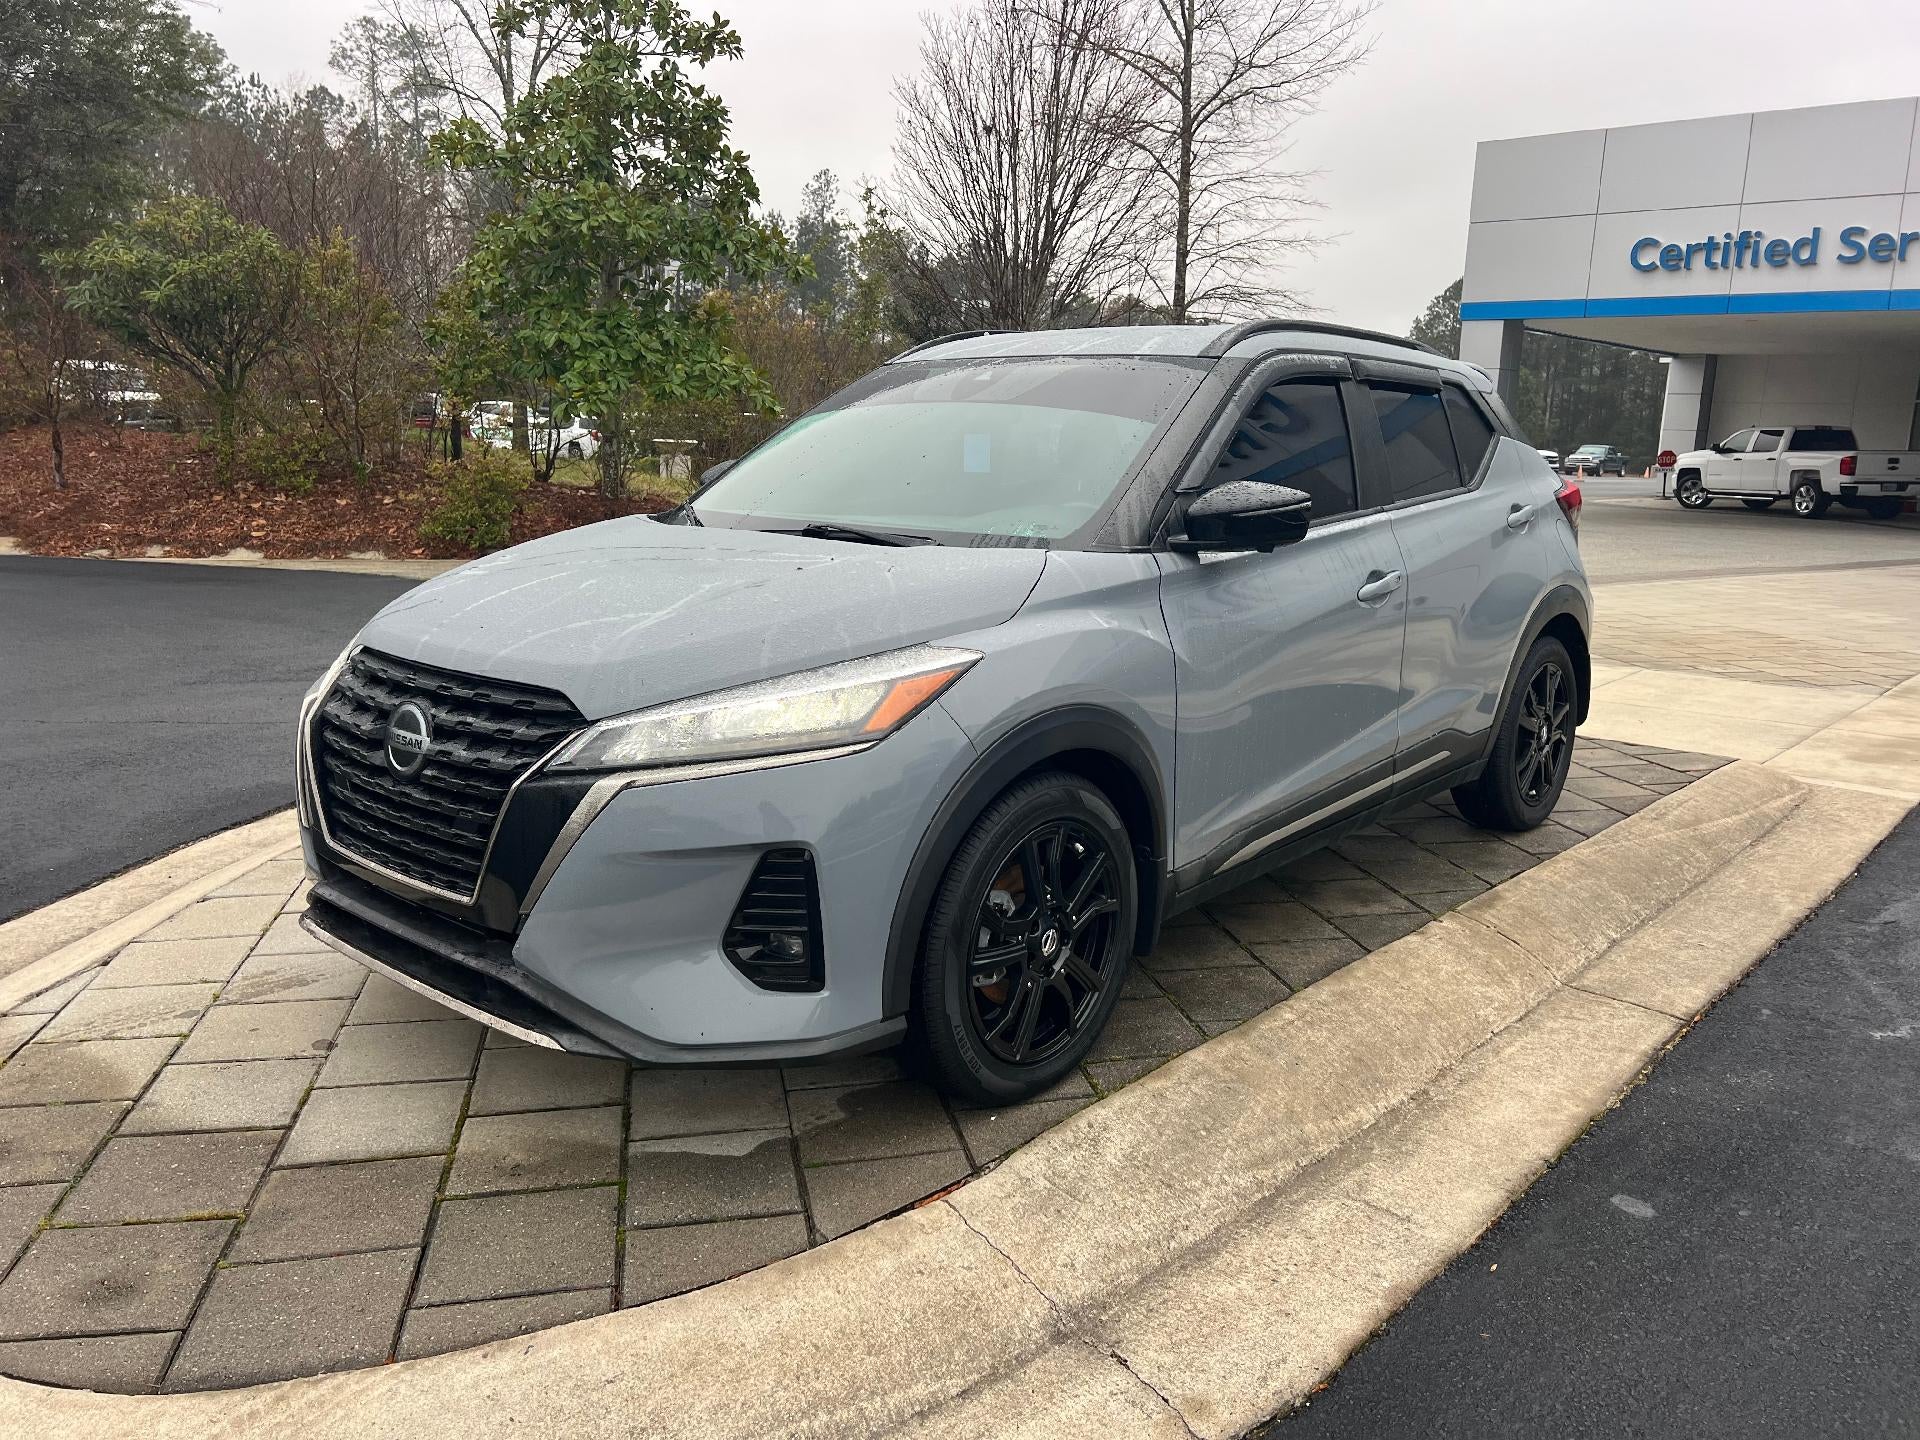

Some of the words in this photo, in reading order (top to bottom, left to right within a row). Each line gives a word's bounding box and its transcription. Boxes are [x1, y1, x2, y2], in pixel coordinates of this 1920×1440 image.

[1630, 226, 1821, 272] Certified
[1837, 226, 1920, 264] Ser
[1658, 455, 1675, 463] STOP
